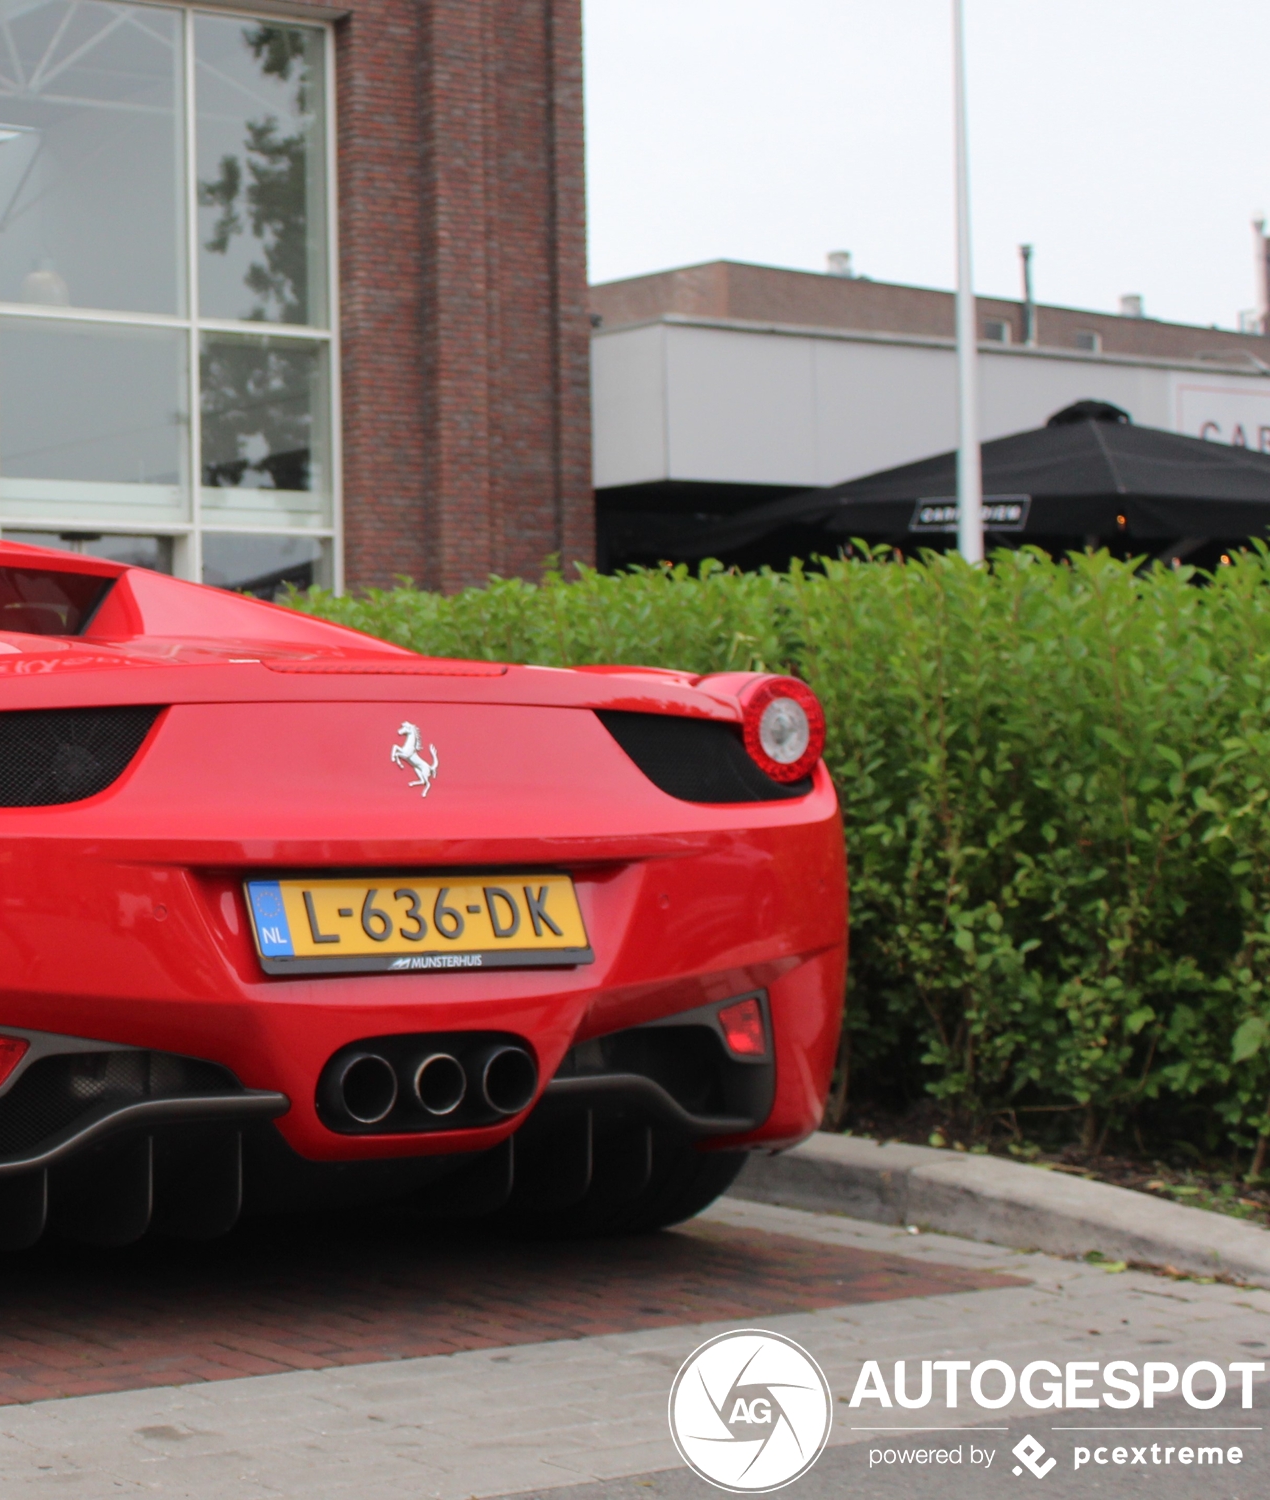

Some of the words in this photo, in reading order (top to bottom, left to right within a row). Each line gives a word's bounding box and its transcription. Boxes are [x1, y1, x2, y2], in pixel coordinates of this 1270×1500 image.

[302, 886, 564, 944] L-636-DK
[262, 928, 287, 944] NL
[411, 954, 482, 969] MUNSTERHUIS
